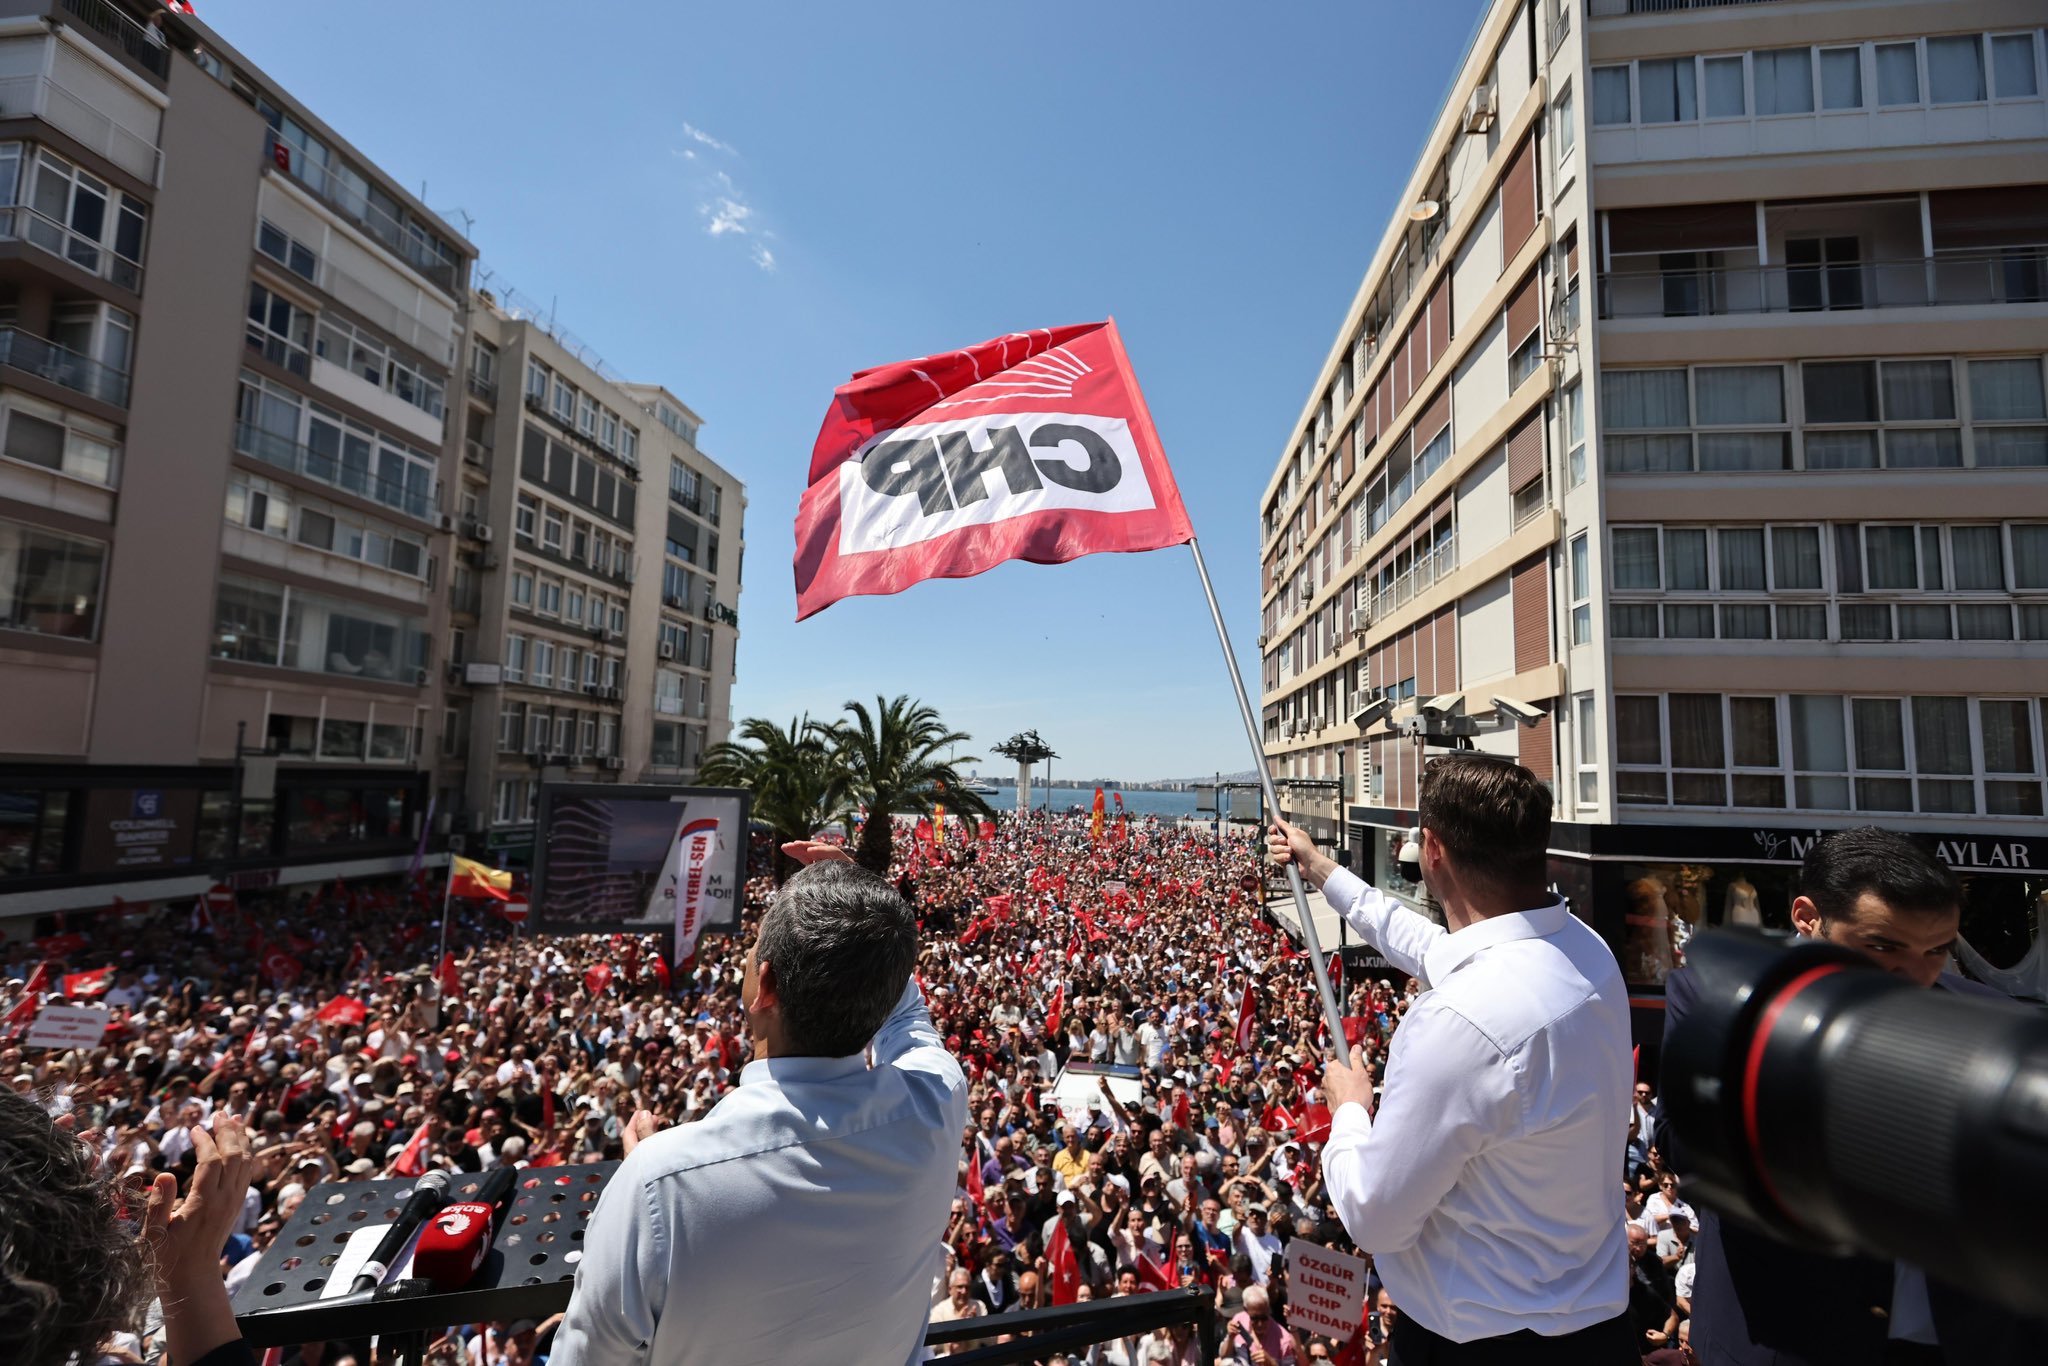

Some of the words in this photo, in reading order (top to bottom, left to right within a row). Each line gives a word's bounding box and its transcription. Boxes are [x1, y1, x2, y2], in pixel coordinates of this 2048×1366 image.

[1935, 840, 2031, 868] AYLAR
[685, 836, 708, 904] YEREL-SEN
[1299, 1252, 1354, 1282] ÖZGÜR
[1300, 1272, 1352, 1300] LİDER,
[1308, 1293, 1341, 1311] CHP
